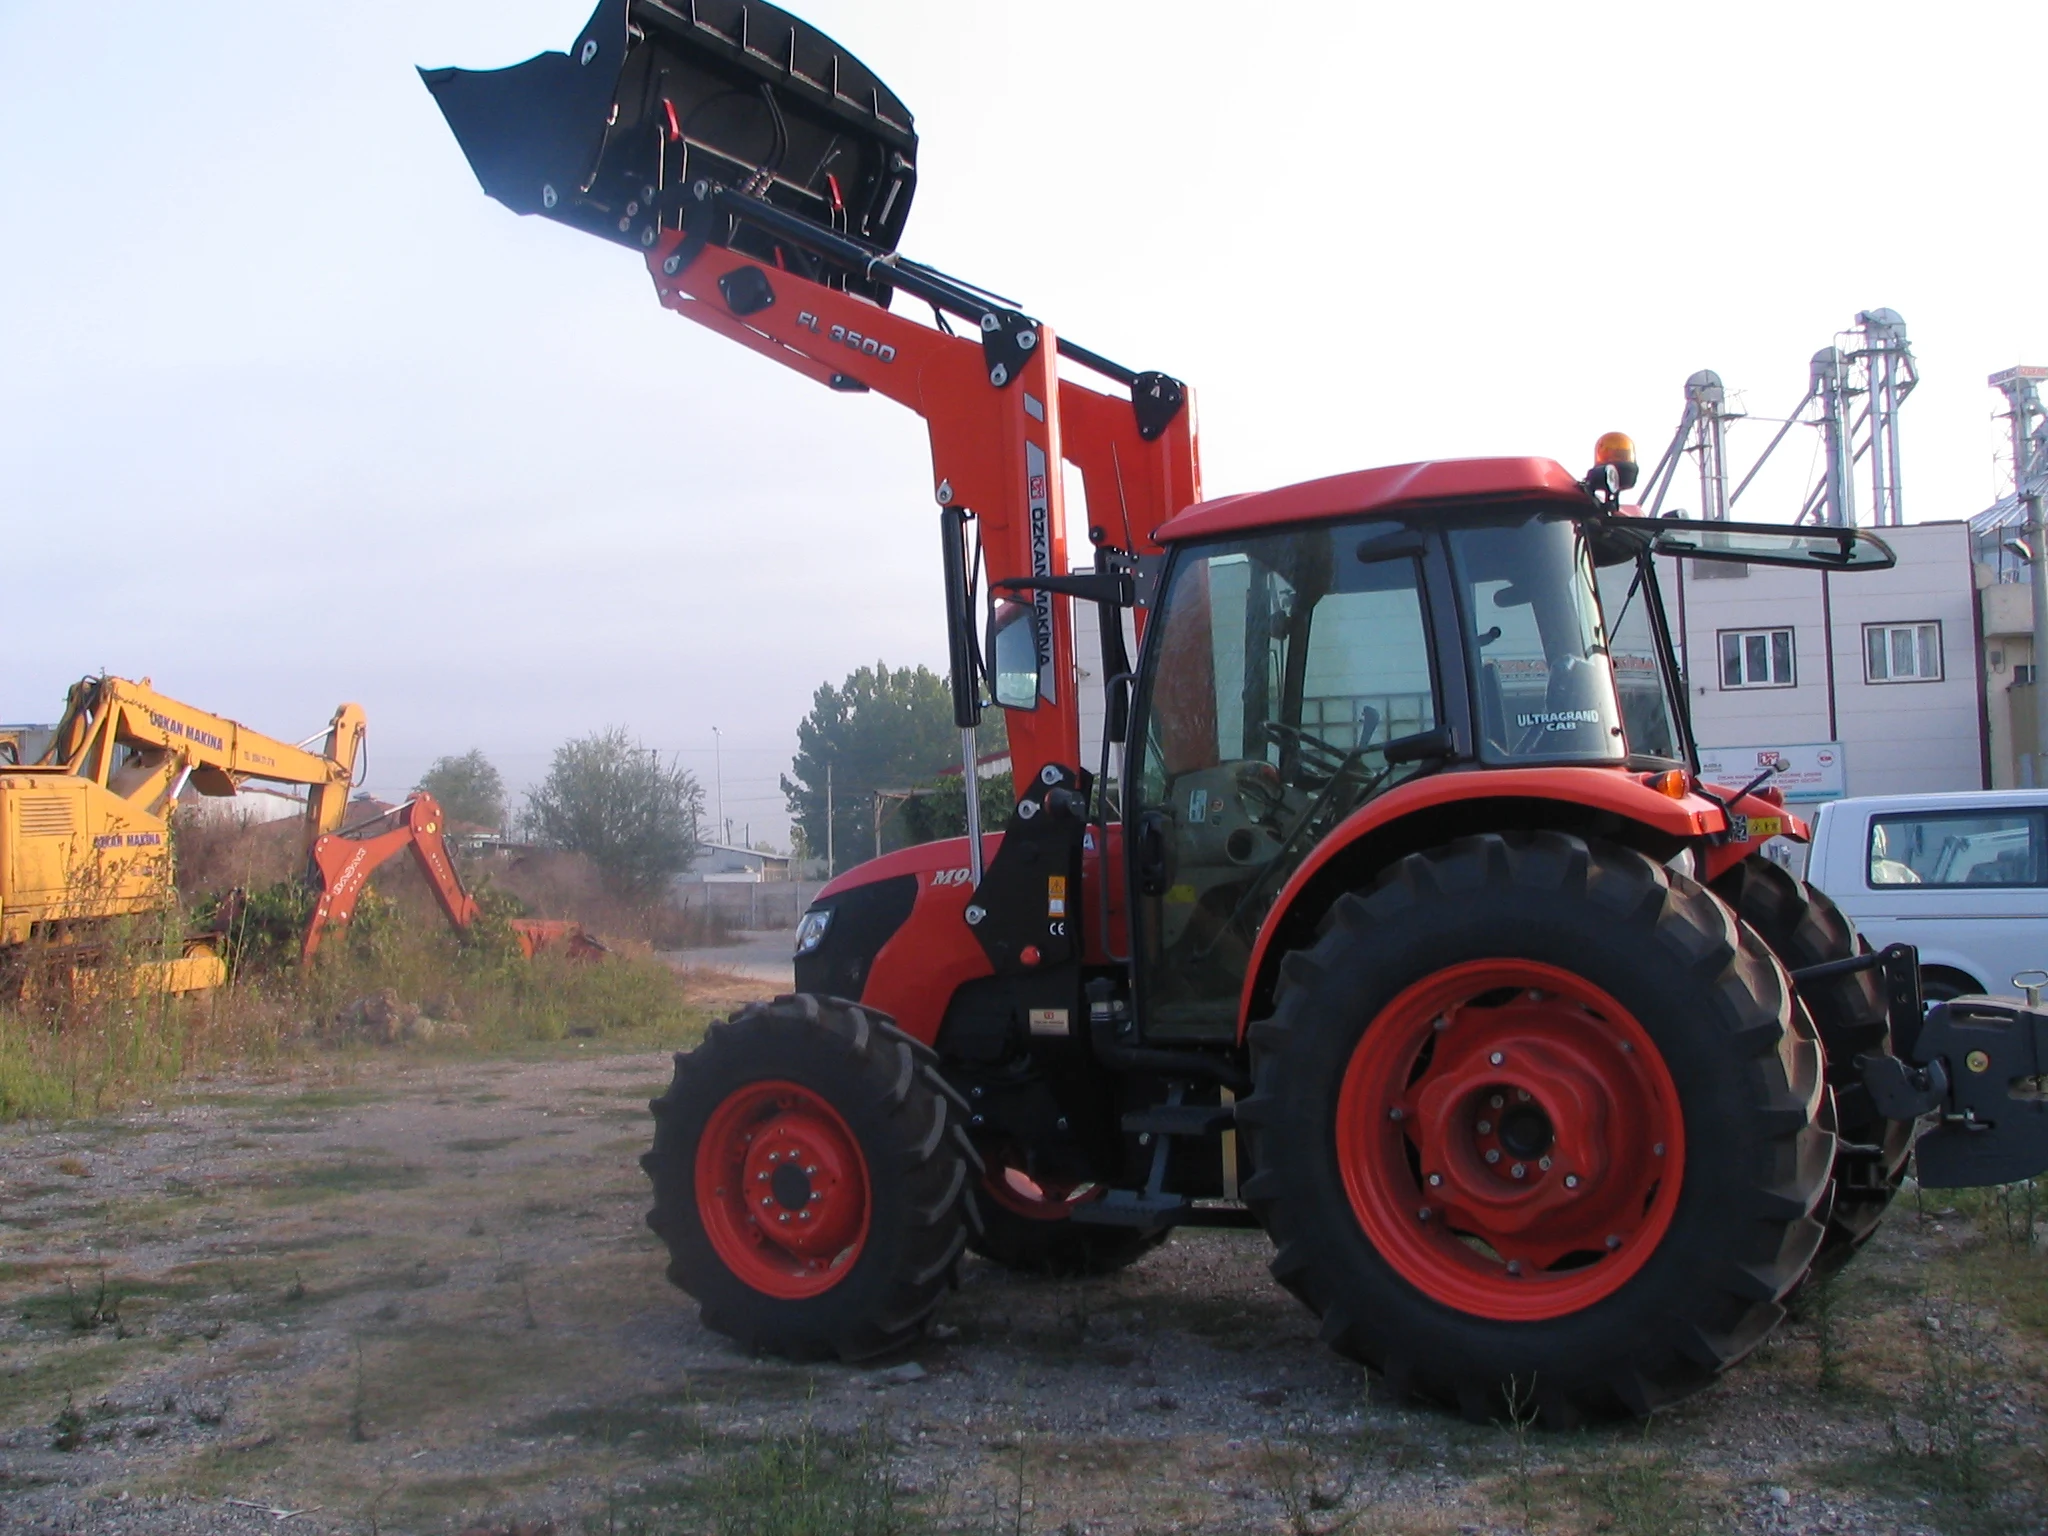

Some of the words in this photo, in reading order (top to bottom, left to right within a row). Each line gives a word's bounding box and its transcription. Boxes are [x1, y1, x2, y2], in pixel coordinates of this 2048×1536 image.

[797, 311, 821, 334] FL
[828, 324, 896, 363] 3500
[1517, 710, 1599, 727] ULTRAGRAND
[1546, 722, 1577, 731] CAB
[931, 868, 973, 887] M9
